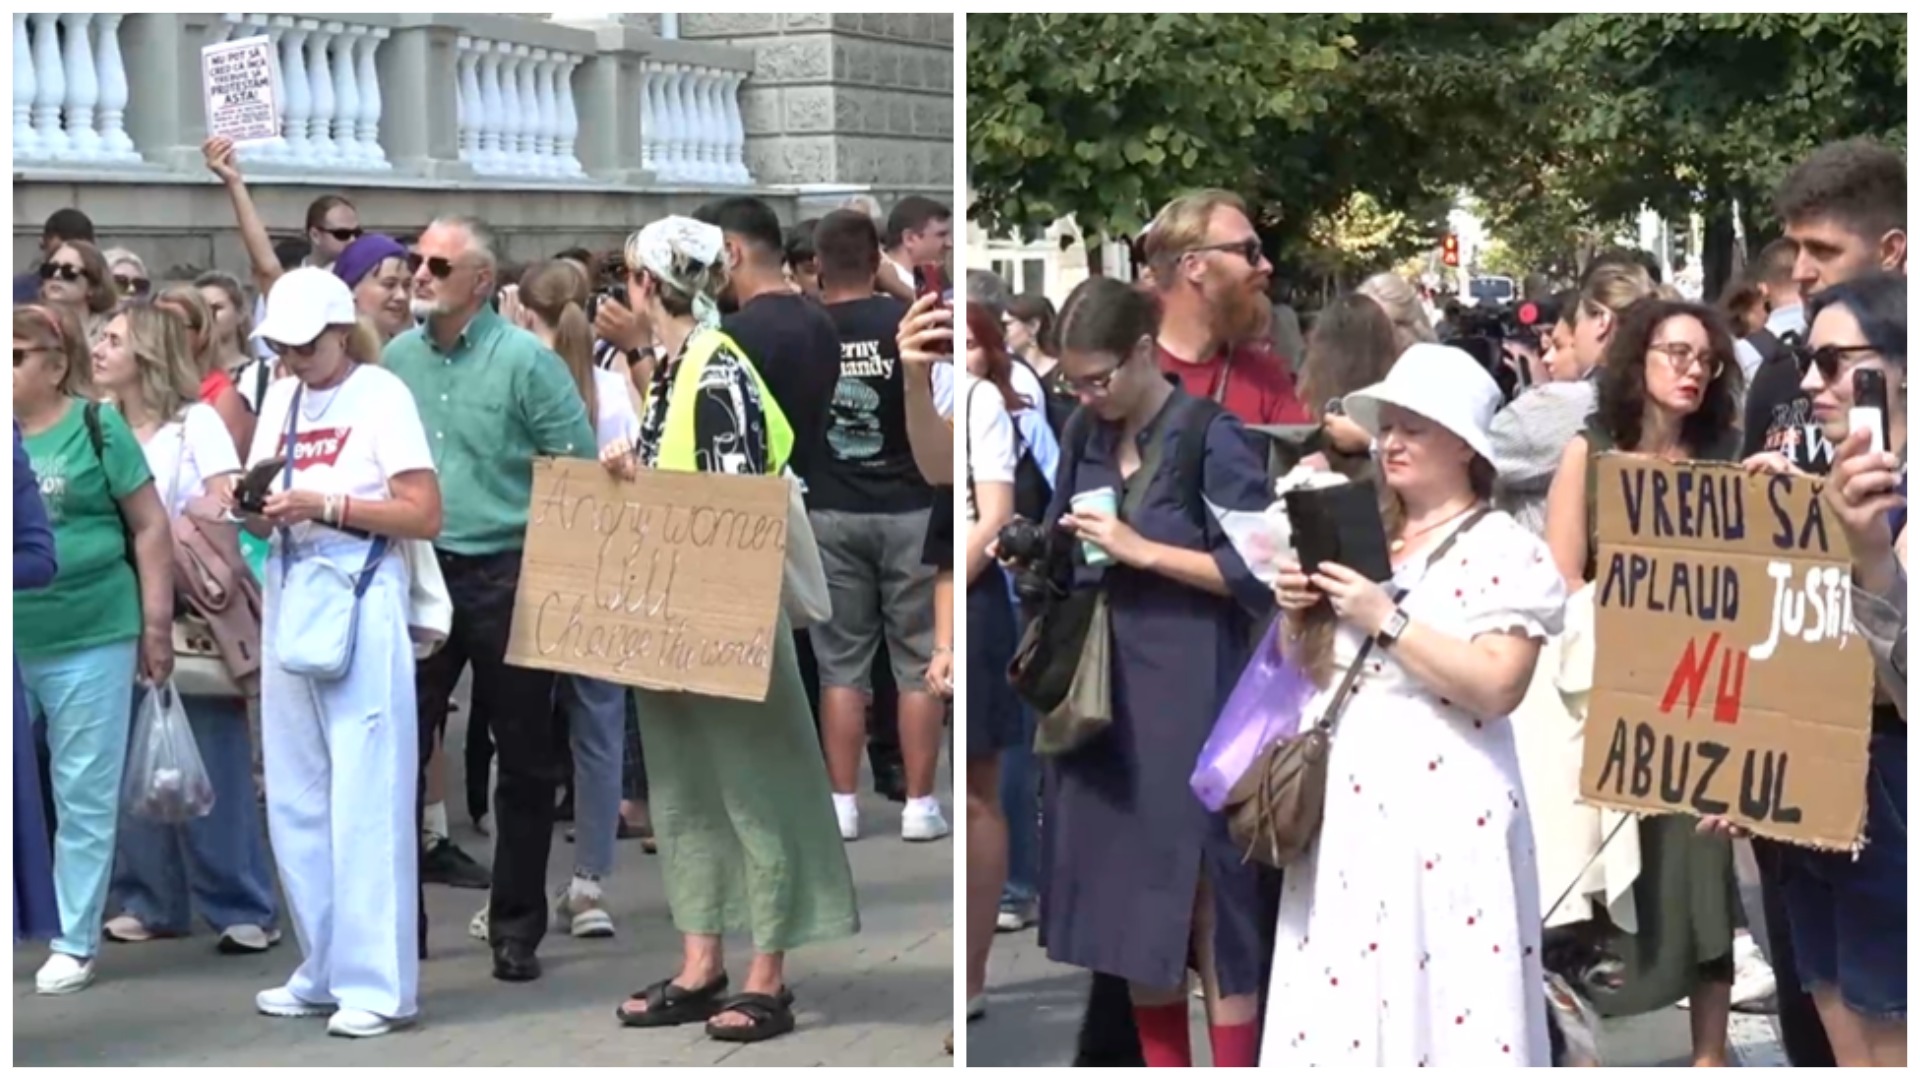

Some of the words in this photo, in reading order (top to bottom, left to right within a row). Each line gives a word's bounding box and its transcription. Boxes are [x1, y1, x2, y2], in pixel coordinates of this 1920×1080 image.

[535, 469, 650, 553] Angry
[663, 503, 786, 550] women
[1620, 469, 1745, 541] VREAU
[1767, 474, 1829, 553] SĂ
[1600, 552, 1740, 622] APLAUD
[535, 591, 652, 672] Change
[1659, 631, 1748, 725] NU
[1596, 717, 1803, 825] ABUZUL
